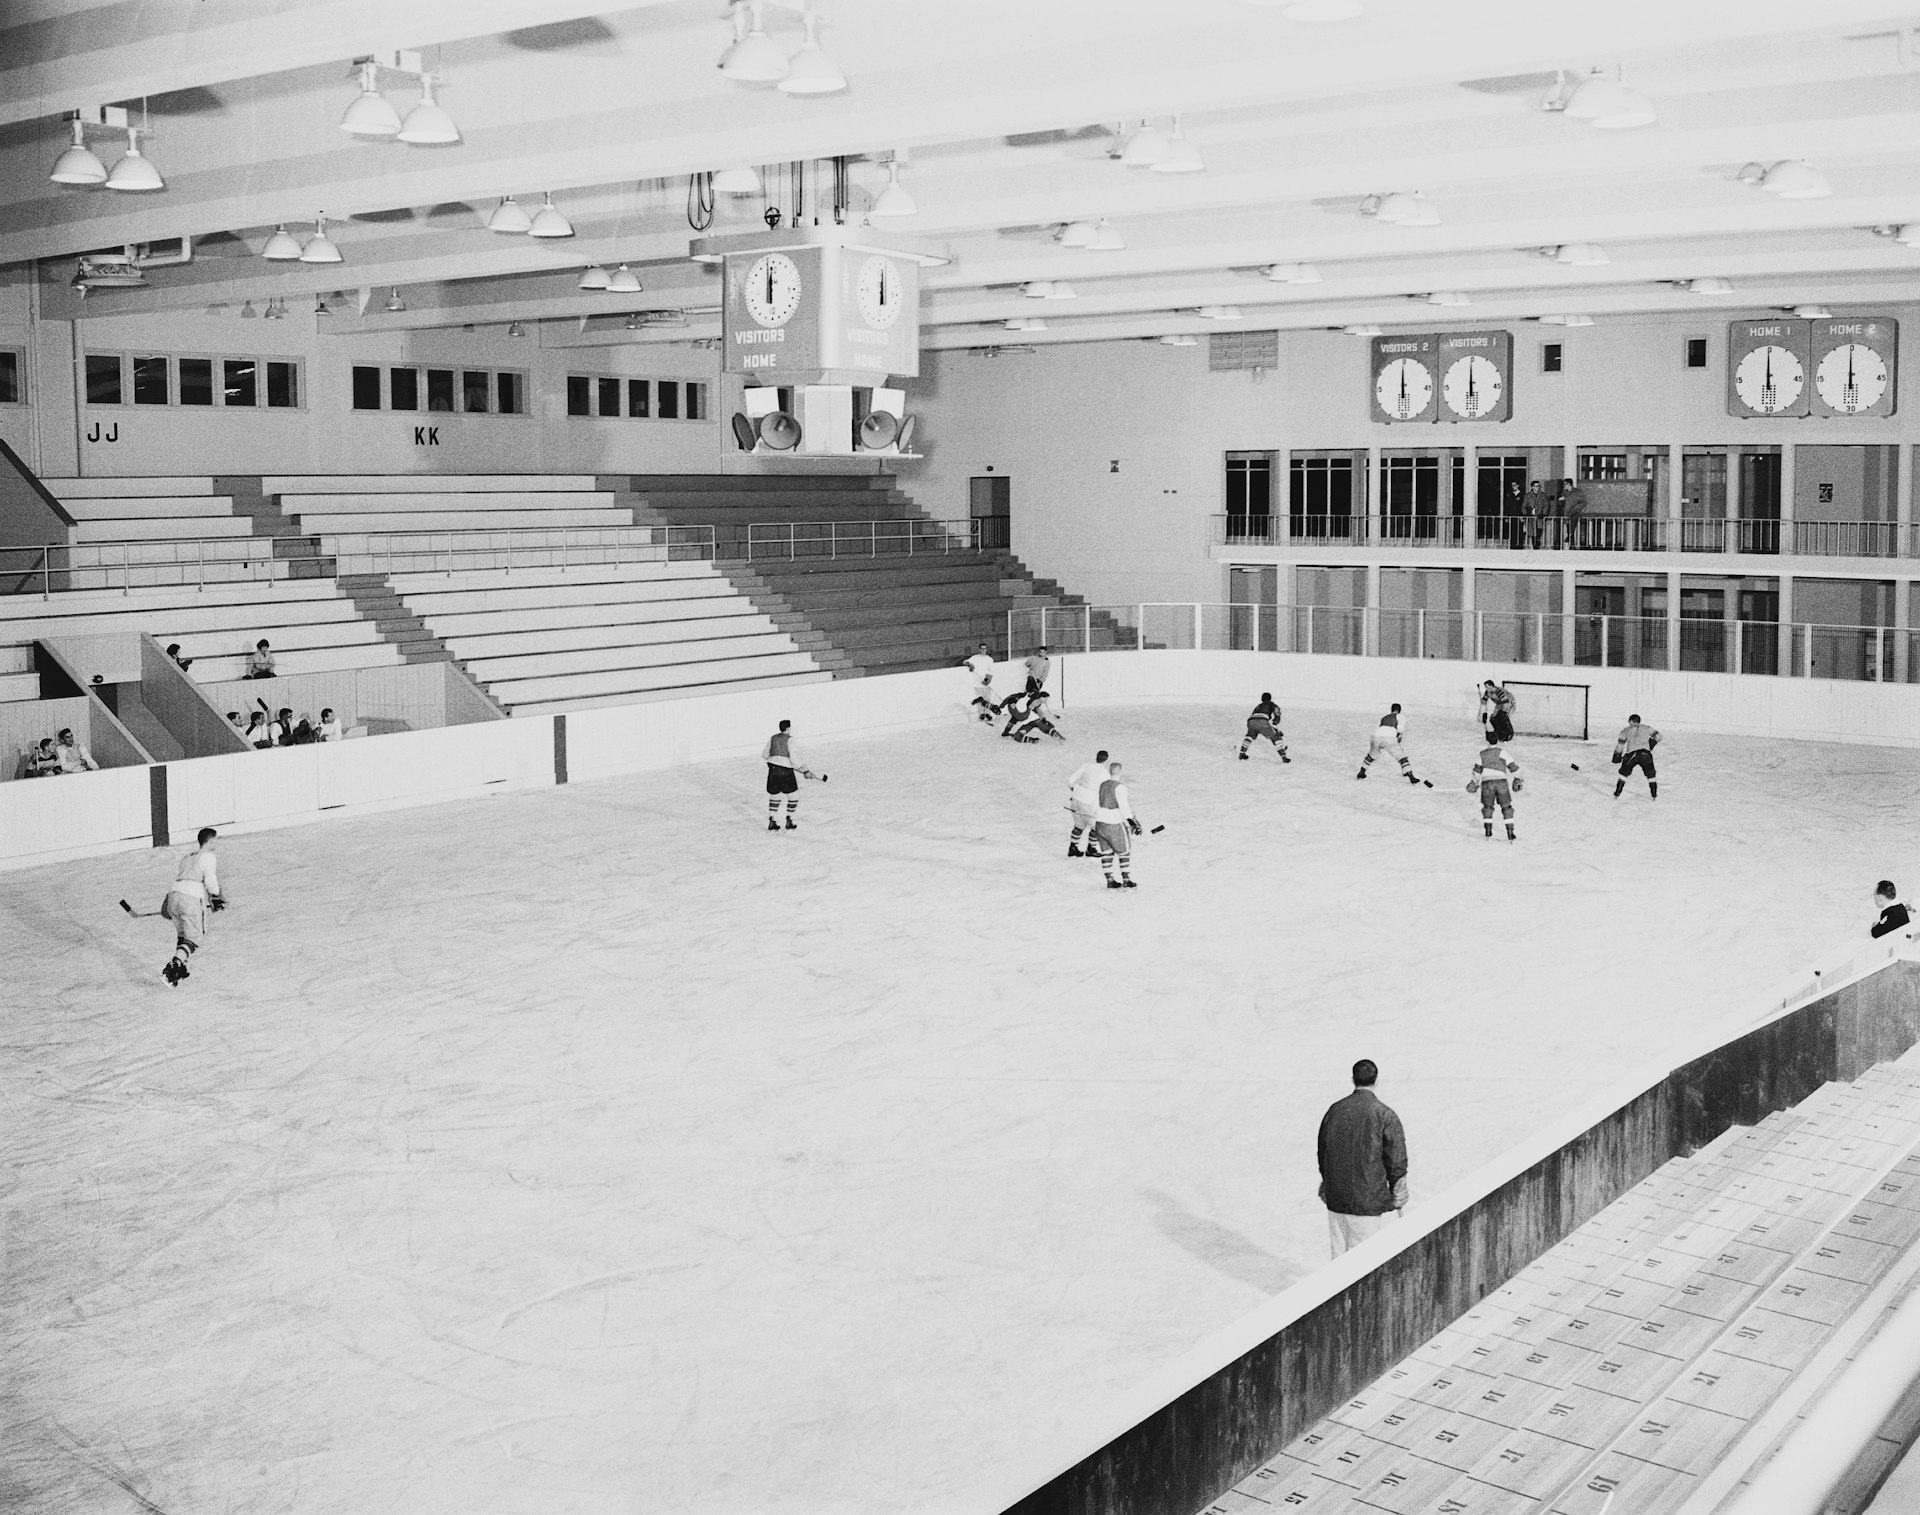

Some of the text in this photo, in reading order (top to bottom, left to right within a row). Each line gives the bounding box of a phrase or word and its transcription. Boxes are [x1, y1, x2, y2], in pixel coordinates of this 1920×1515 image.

[1750, 326, 1791, 337] HOME 1
[1829, 324, 1876, 334] HOME 2
[735, 329, 785, 345] VISITORS
[847, 328, 889, 345] VISITORS
[1449, 337, 1488, 347] VISITORS
[1380, 342, 1429, 353] VISITORS 2
[743, 354, 777, 369] HOME
[1876, 374, 1886, 382] 45
[1764, 405, 1774, 413] 30
[87, 423, 119, 442] JJ
[414, 427, 440, 446] KK
[1880, 1183, 1901, 1193] 12
[1849, 1214, 1873, 1226] 13
[1749, 1224, 1770, 1234] 11
[1816, 1247, 1842, 1259] 14
[1717, 1254, 1740, 1265] 12
[1605, 1289, 1625, 1298] 11
[1680, 1285, 1705, 1296] 13
[1780, 1284, 1806, 1297] 15
[1568, 1319, 1591, 1330] 12
[1640, 1321, 1666, 1333] 14
[1736, 1326, 1764, 1341] 16
[1472, 1347, 1493, 1357] 11
[1526, 1352, 1550, 1364] 13
[1598, 1361, 1624, 1374] 15
[1432, 1378, 1453, 1390] 12
[1691, 1371, 1721, 1387] 17
[1481, 1390, 1507, 1403] 14
[1349, 1401, 1368, 1410] 11
[1548, 1403, 1576, 1417] 16
[1384, 1414, 1406, 1426] 13
[1304, 1434, 1324, 1445] 12
[1435, 1430, 1460, 1444] 15
[1336, 1450, 1362, 1464] 14
[1500, 1449, 1527, 1464] 17
[1256, 1468, 1278, 1480] 13
[1380, 1472, 1407, 1487] 16
[1587, 1475, 1621, 1493] 19
[1285, 1490, 1310, 1506] 15
